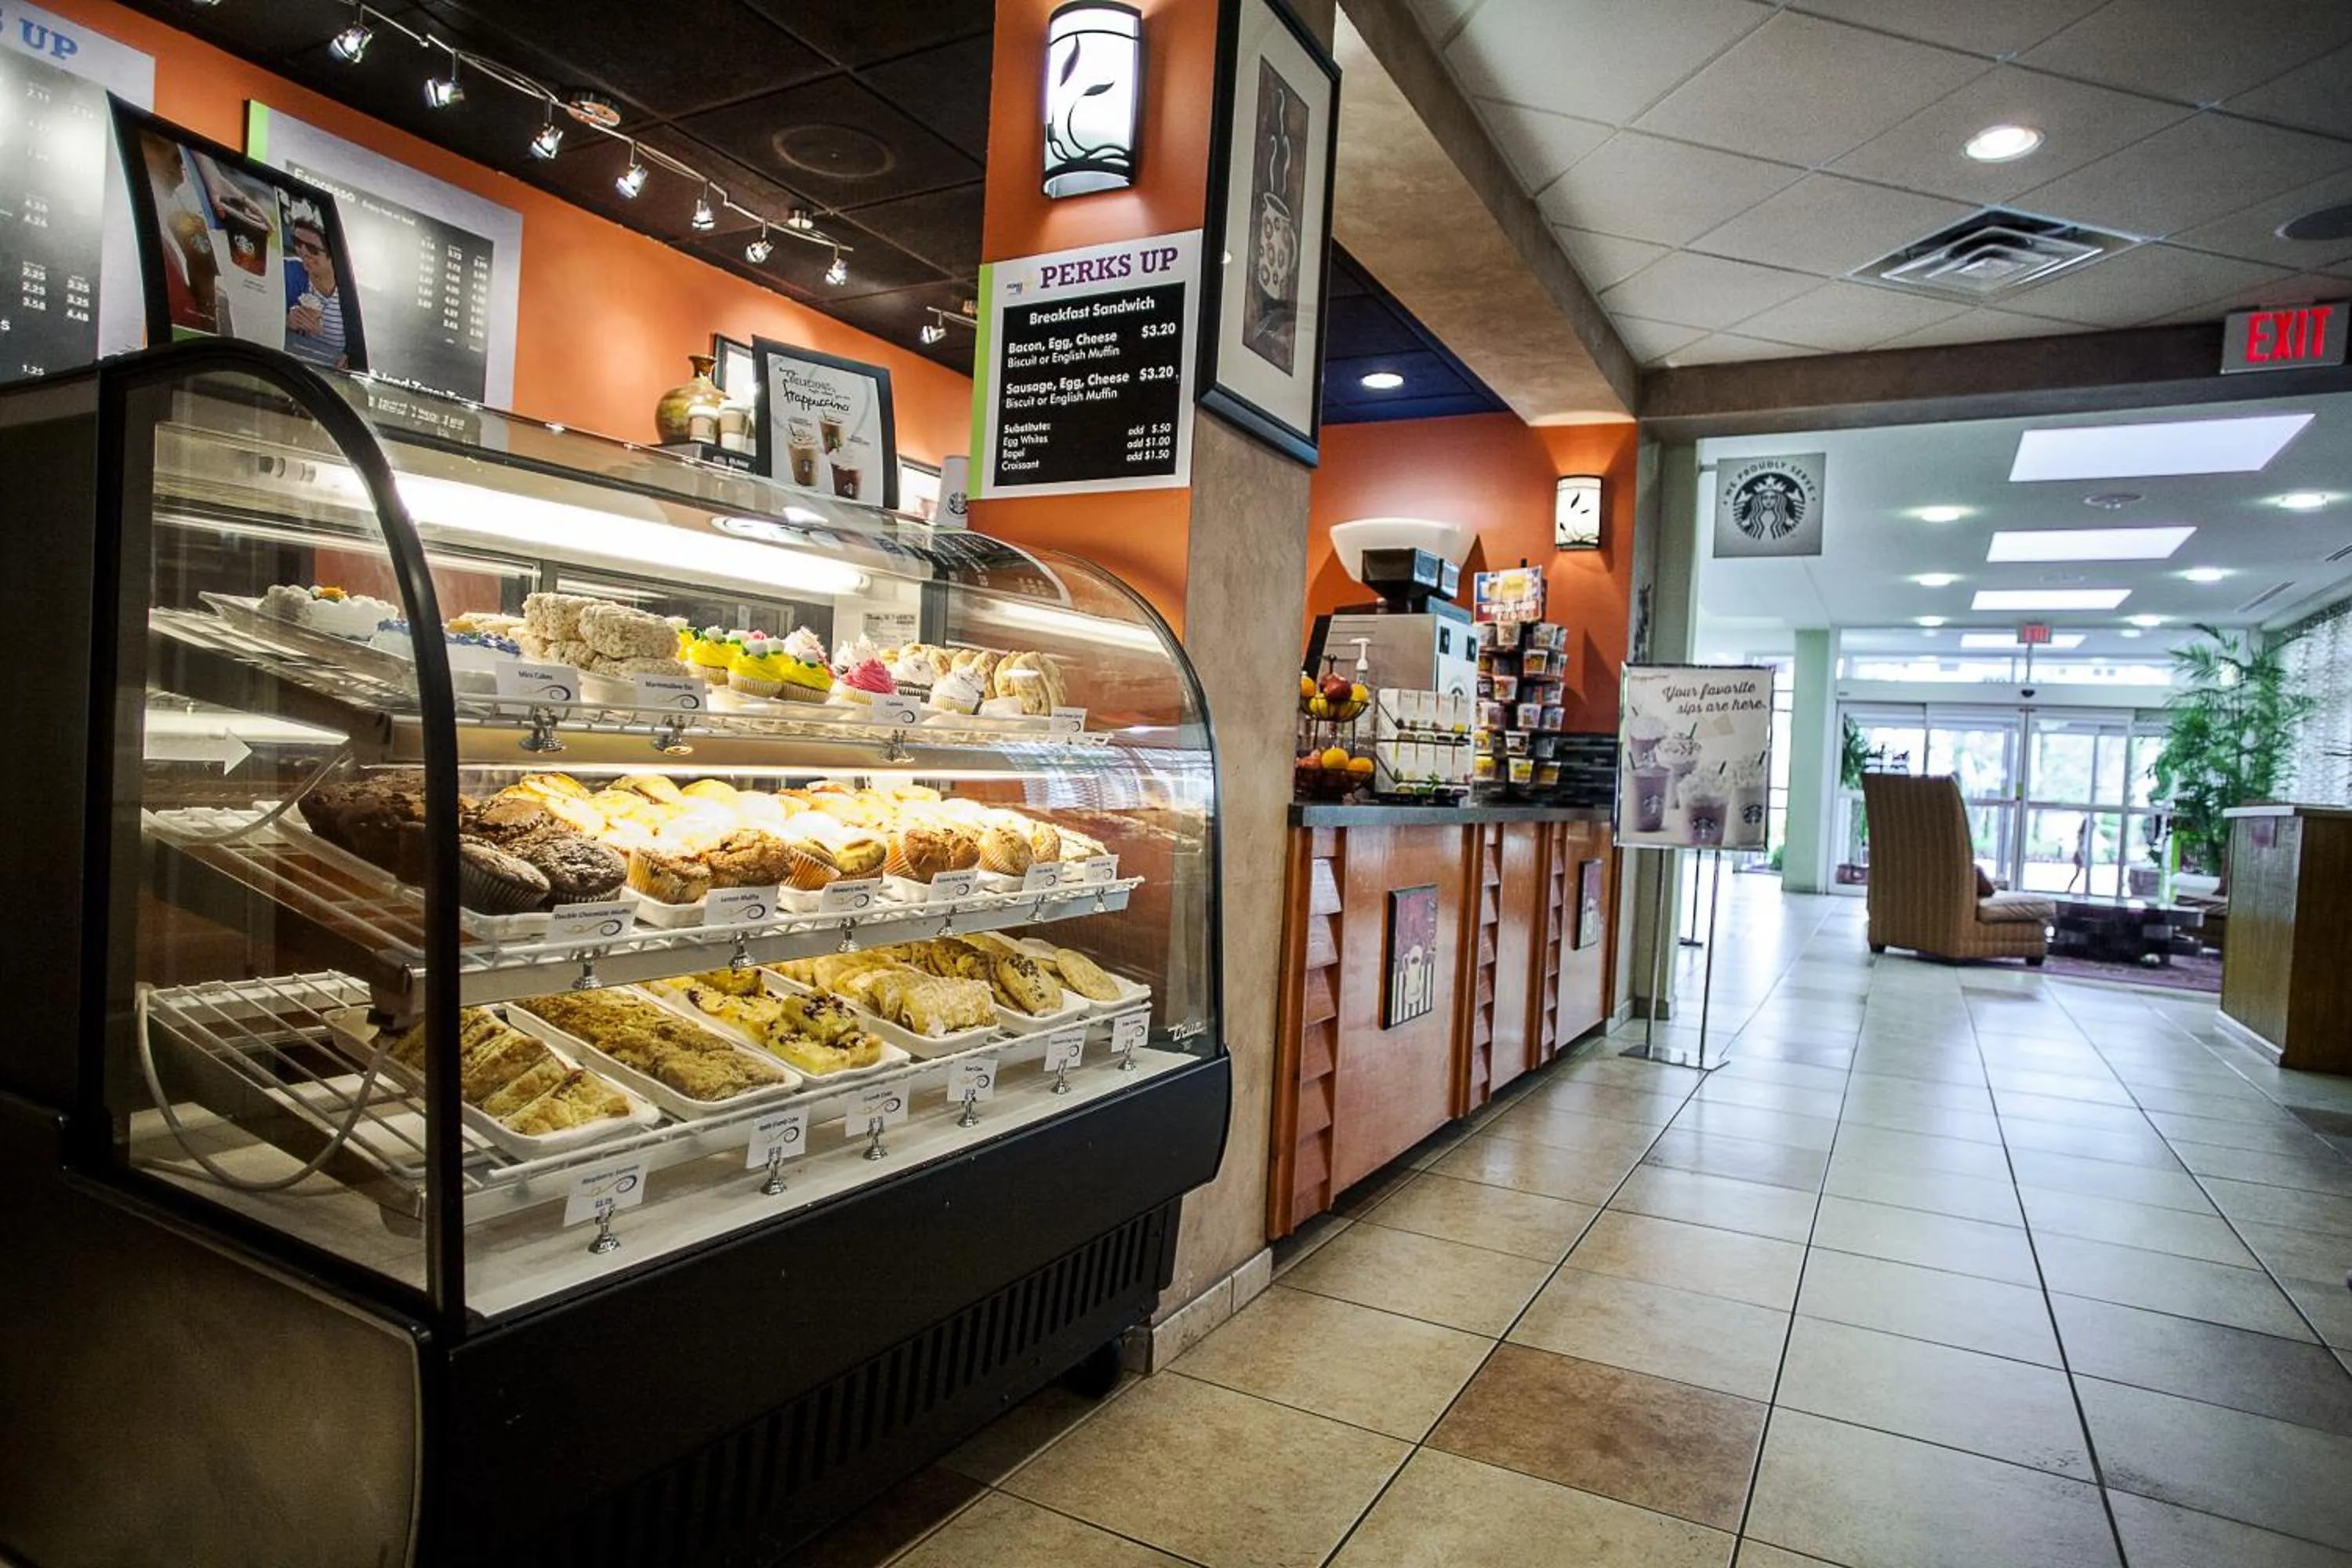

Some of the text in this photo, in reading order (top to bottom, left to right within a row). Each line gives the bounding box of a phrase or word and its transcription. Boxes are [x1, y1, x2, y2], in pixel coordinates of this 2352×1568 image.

[19, 18, 78, 60] UP
[1040, 252, 1132, 289] PERKS
[1140, 247, 1178, 273] UP
[1029, 296, 1155, 325] Breakfast Sandwich
[1142, 322, 1176, 339] $3.20
[2245, 306, 2333, 363] EXIT
[1008, 331, 1117, 354] Bacon, Egg, Cheese
[1007, 345, 1120, 368] Biscuit or English Muffin
[1006, 372, 1130, 394] Sausage, Egg, Cheese
[1139, 365, 1174, 382] $3.20
[1005, 387, 1117, 408] Biscuit or English Muffin
[1003, 437, 1018, 448] Egg
[1001, 459, 1040, 471] Croissant
[1737, 461, 1787, 480] PROUDLY
[1791, 465, 1816, 492] SERVE
[1662, 681, 1755, 702] Your favorite
[1676, 698, 1766, 716] sips are here.
